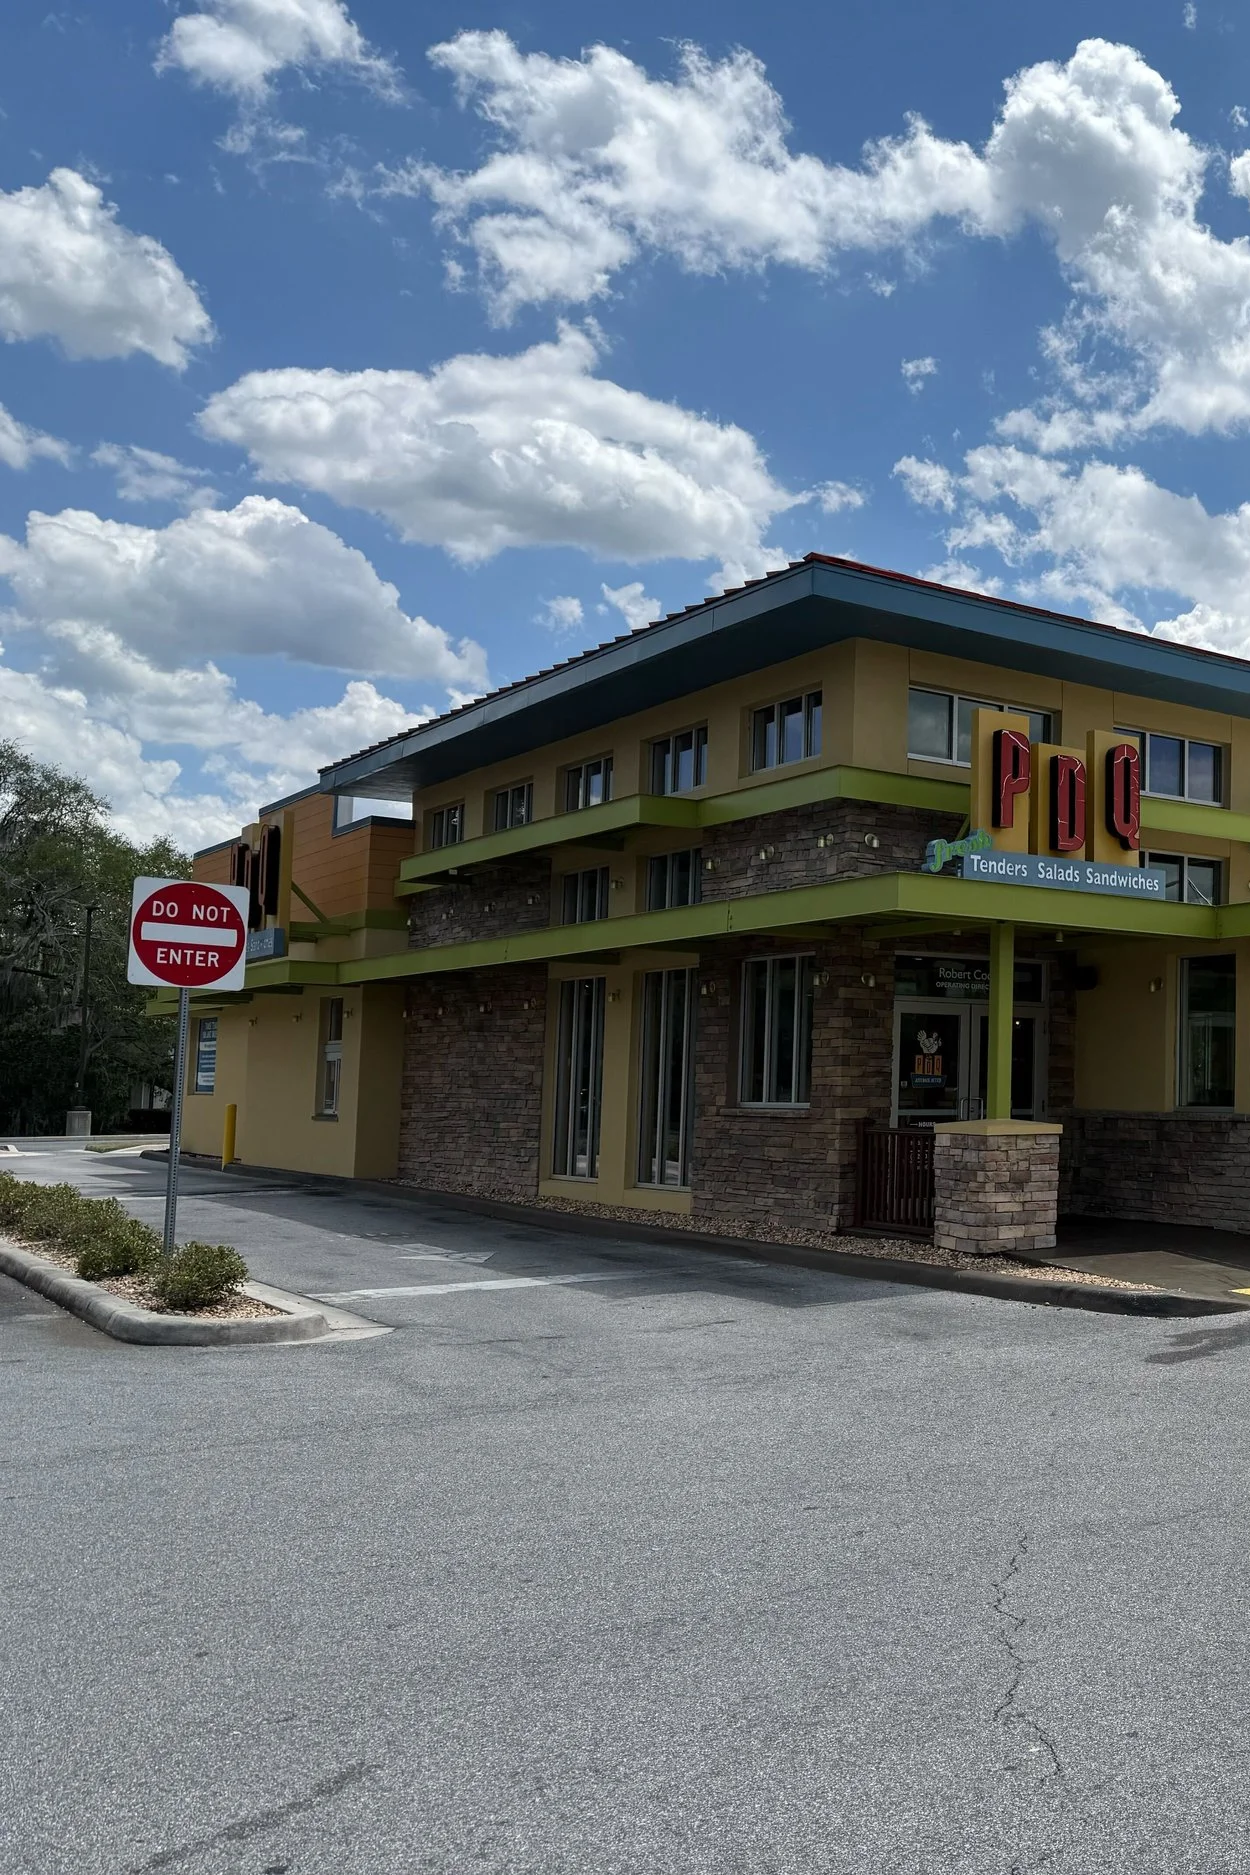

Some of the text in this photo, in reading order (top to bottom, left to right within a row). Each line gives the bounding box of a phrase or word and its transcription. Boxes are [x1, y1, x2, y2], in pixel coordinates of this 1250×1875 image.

[992, 729, 1140, 851] PDQ
[970, 854, 1159, 891] Tenders Salads Sandwiches
[152, 900, 231, 922] DO NOT
[156, 948, 220, 967] ENTER
[939, 968, 971, 980] Robert
[936, 981, 970, 990] OPERATING
